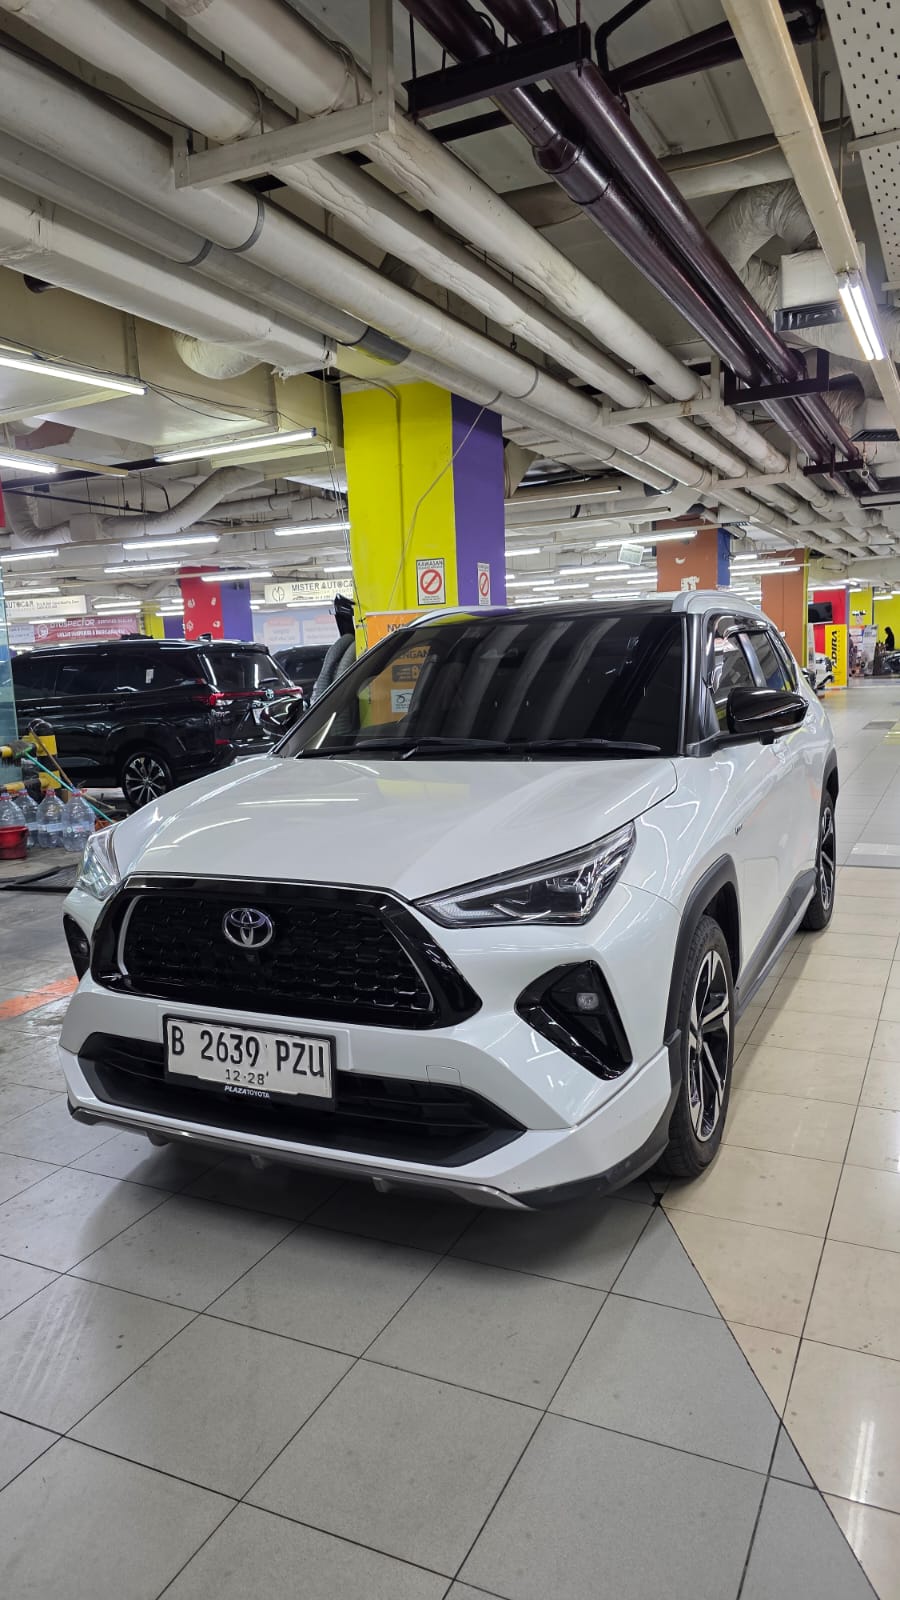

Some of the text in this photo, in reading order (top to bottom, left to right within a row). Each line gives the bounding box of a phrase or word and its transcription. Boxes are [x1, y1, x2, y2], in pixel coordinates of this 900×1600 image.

[291, 582, 319, 592] MISTER
[171, 1025, 325, 1078] B 2639 PZU
